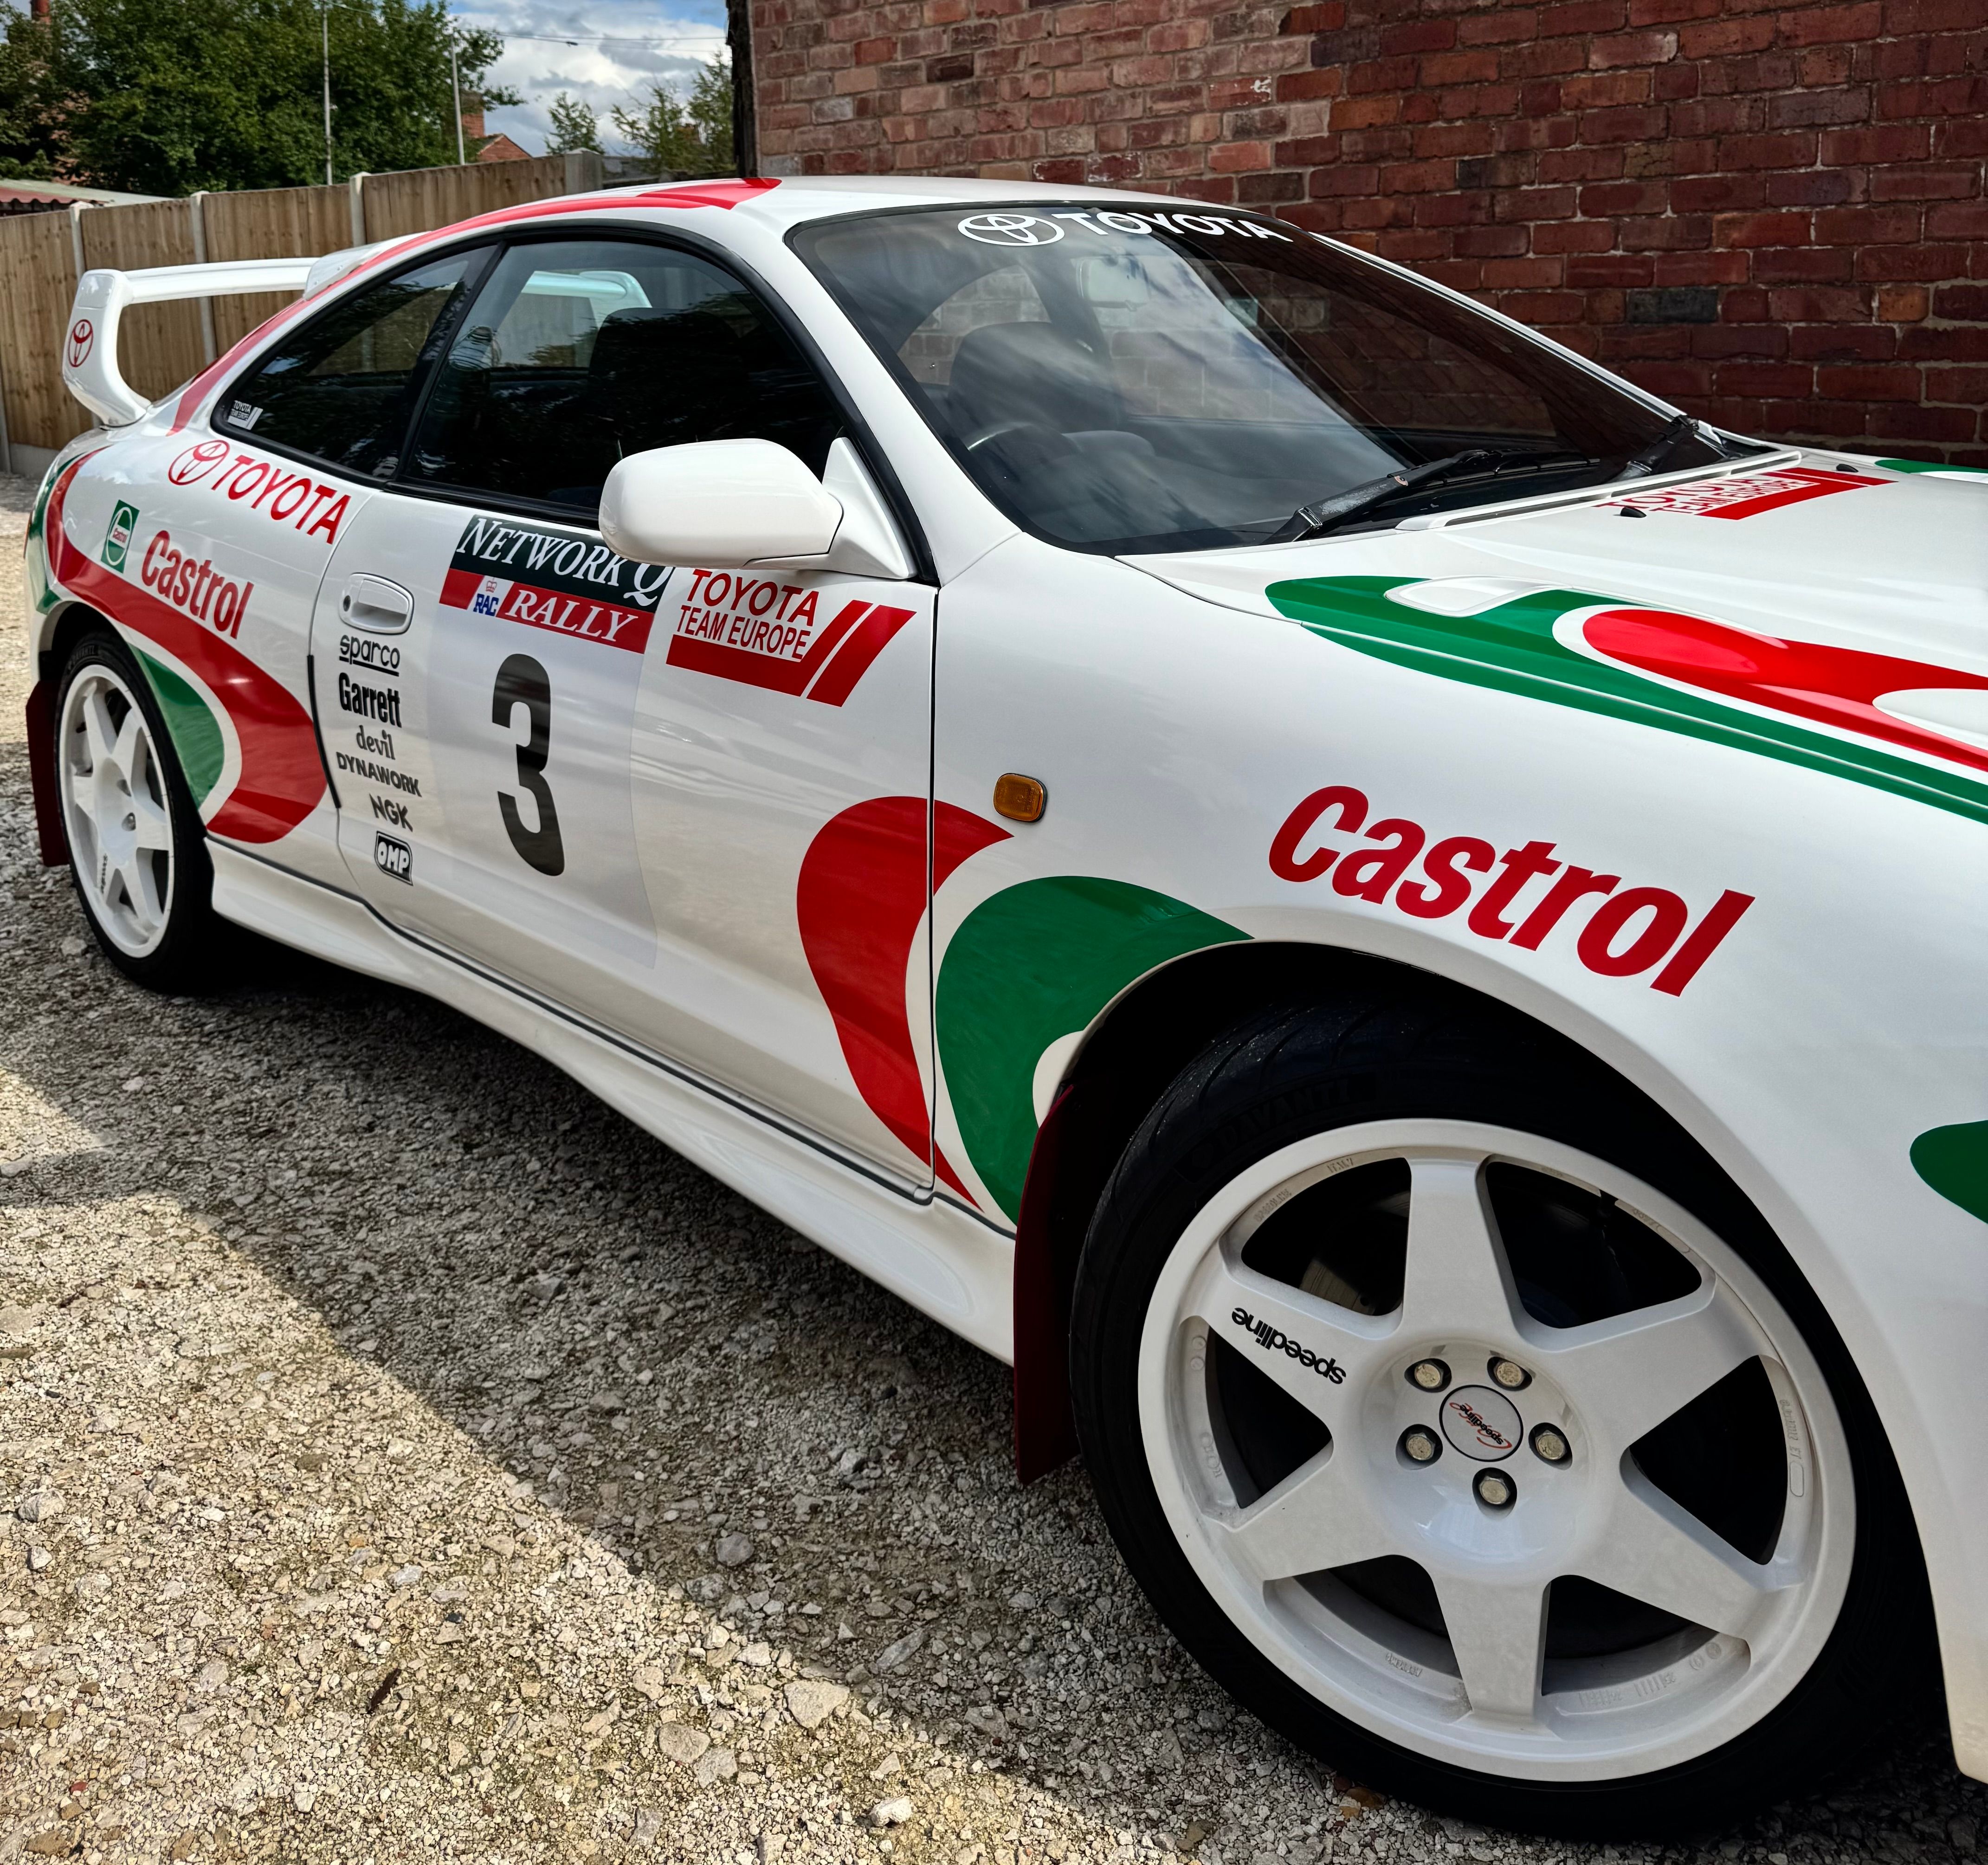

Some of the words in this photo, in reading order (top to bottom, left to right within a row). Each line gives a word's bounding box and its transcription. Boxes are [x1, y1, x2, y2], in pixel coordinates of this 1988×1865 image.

[1052, 212, 1294, 242] TOYOTA
[212, 455, 351, 544] TOYOTA
[1591, 478, 1765, 509] TOYOTA
[1649, 496, 1738, 514] TEAM
[1711, 480, 1815, 498] EUROPE
[142, 530, 254, 639] Castrol
[456, 519, 628, 587] NETWORK
[623, 563, 673, 607] Q
[473, 593, 499, 616] RAC
[508, 589, 639, 643] RALLY
[686, 568, 819, 627] TOYOTA
[339, 634, 400, 669] sparco
[676, 605, 727, 642] TEAM
[727, 617, 811, 661] EUROPE
[338, 672, 402, 728] Garrett
[356, 725, 395, 760] devil
[491, 653, 565, 876] 3
[336, 752, 422, 798] DYNAWORK
[369, 793, 413, 832] NGK
[377, 841, 410, 874] OMP
[1269, 785, 1756, 997] Castrol
[1231, 1307, 1347, 1385] speedline
[1459, 1404, 1504, 1446] speedline
